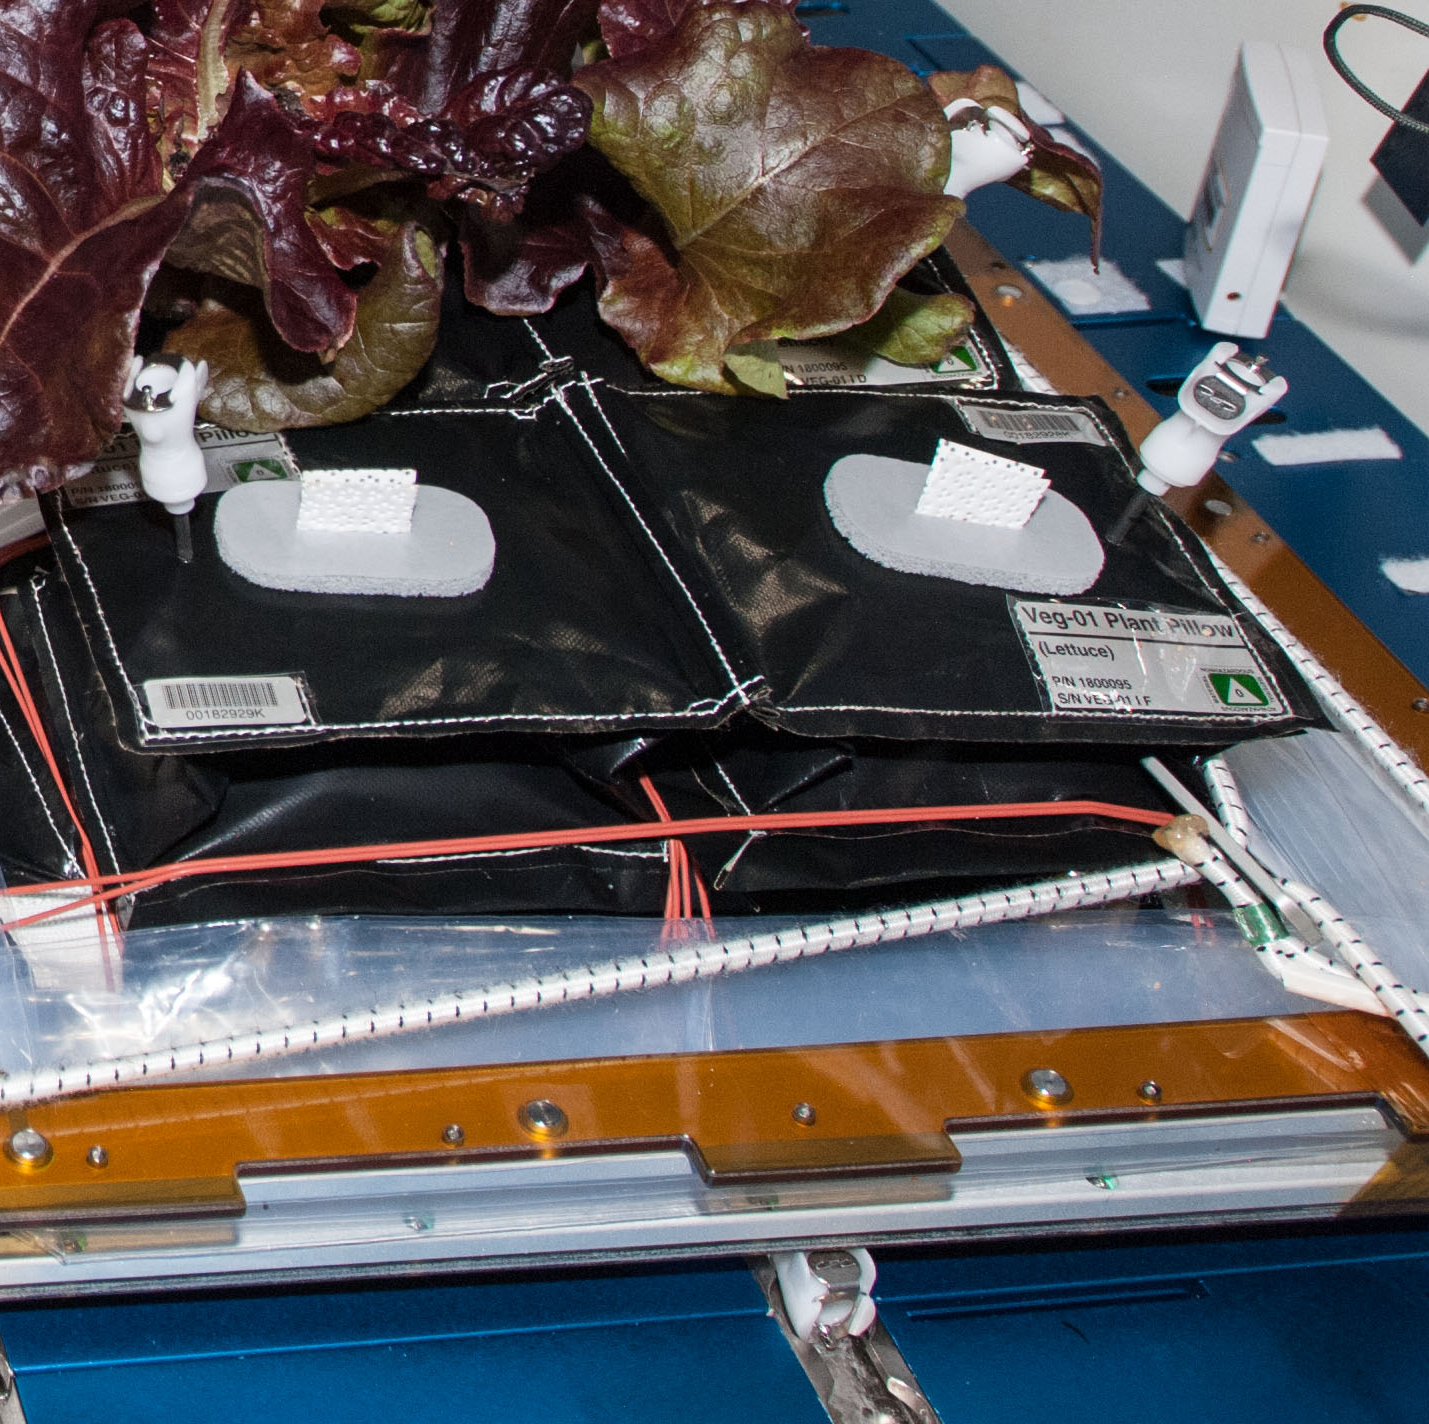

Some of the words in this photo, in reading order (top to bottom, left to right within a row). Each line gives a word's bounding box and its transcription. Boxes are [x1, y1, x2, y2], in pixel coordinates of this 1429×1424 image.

[797, 361, 849, 374] 1800095
[1022, 606, 1098, 629] Veg-01
[1104, 612, 1162, 634] Plant
[1165, 617, 1235, 638] Pillow
[1038, 641, 1115, 661] (Lettuce)
[1052, 675, 1076, 688] P/N
[1078, 677, 1132, 690] 1800095
[1057, 692, 1082, 705] S/N
[186, 708, 266, 721] 00182929K
